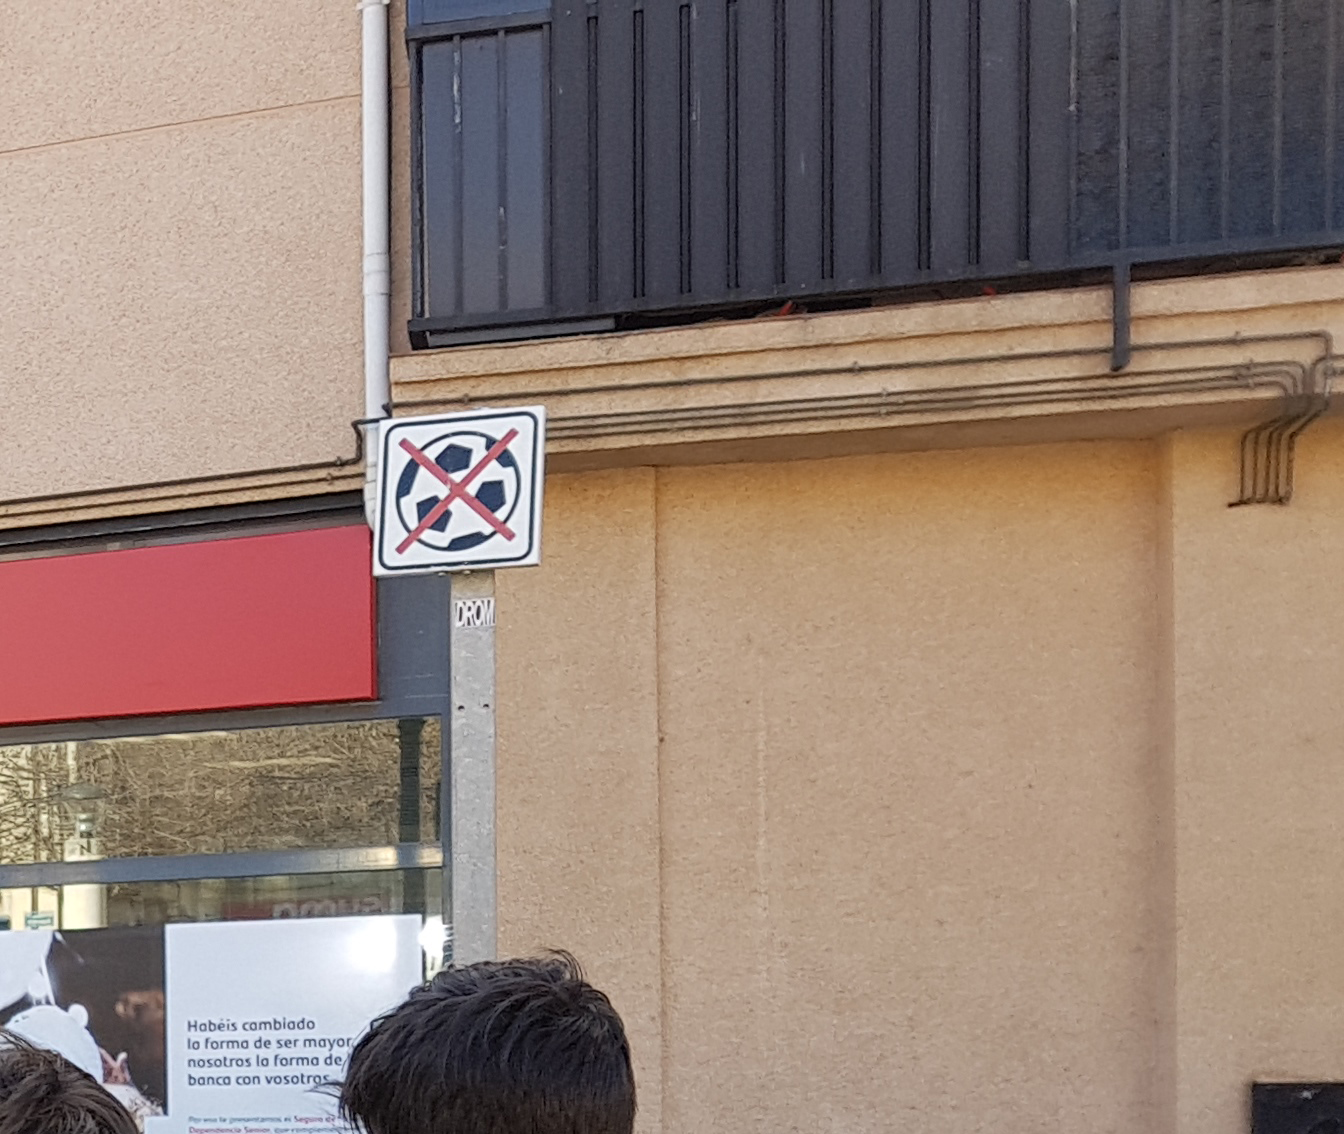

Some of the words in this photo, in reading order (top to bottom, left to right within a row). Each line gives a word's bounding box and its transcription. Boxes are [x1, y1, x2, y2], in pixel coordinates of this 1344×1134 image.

[187, 1019, 238, 1033] Habéis
[242, 1017, 315, 1031] cambiado
[187, 1038, 200, 1050] la
[205, 1037, 249, 1050] forma
[254, 1036, 271, 1049] de
[276, 1038, 299, 1049] ser
[188, 1057, 251, 1068] nosotros
[256, 1054, 269, 1067] la
[274, 1054, 320, 1067] forma
[324, 1054, 342, 1066] de
[188, 1074, 231, 1086] banca
[236, 1075, 260, 1086] con
[294, 1115, 323, 1125] Seguro
